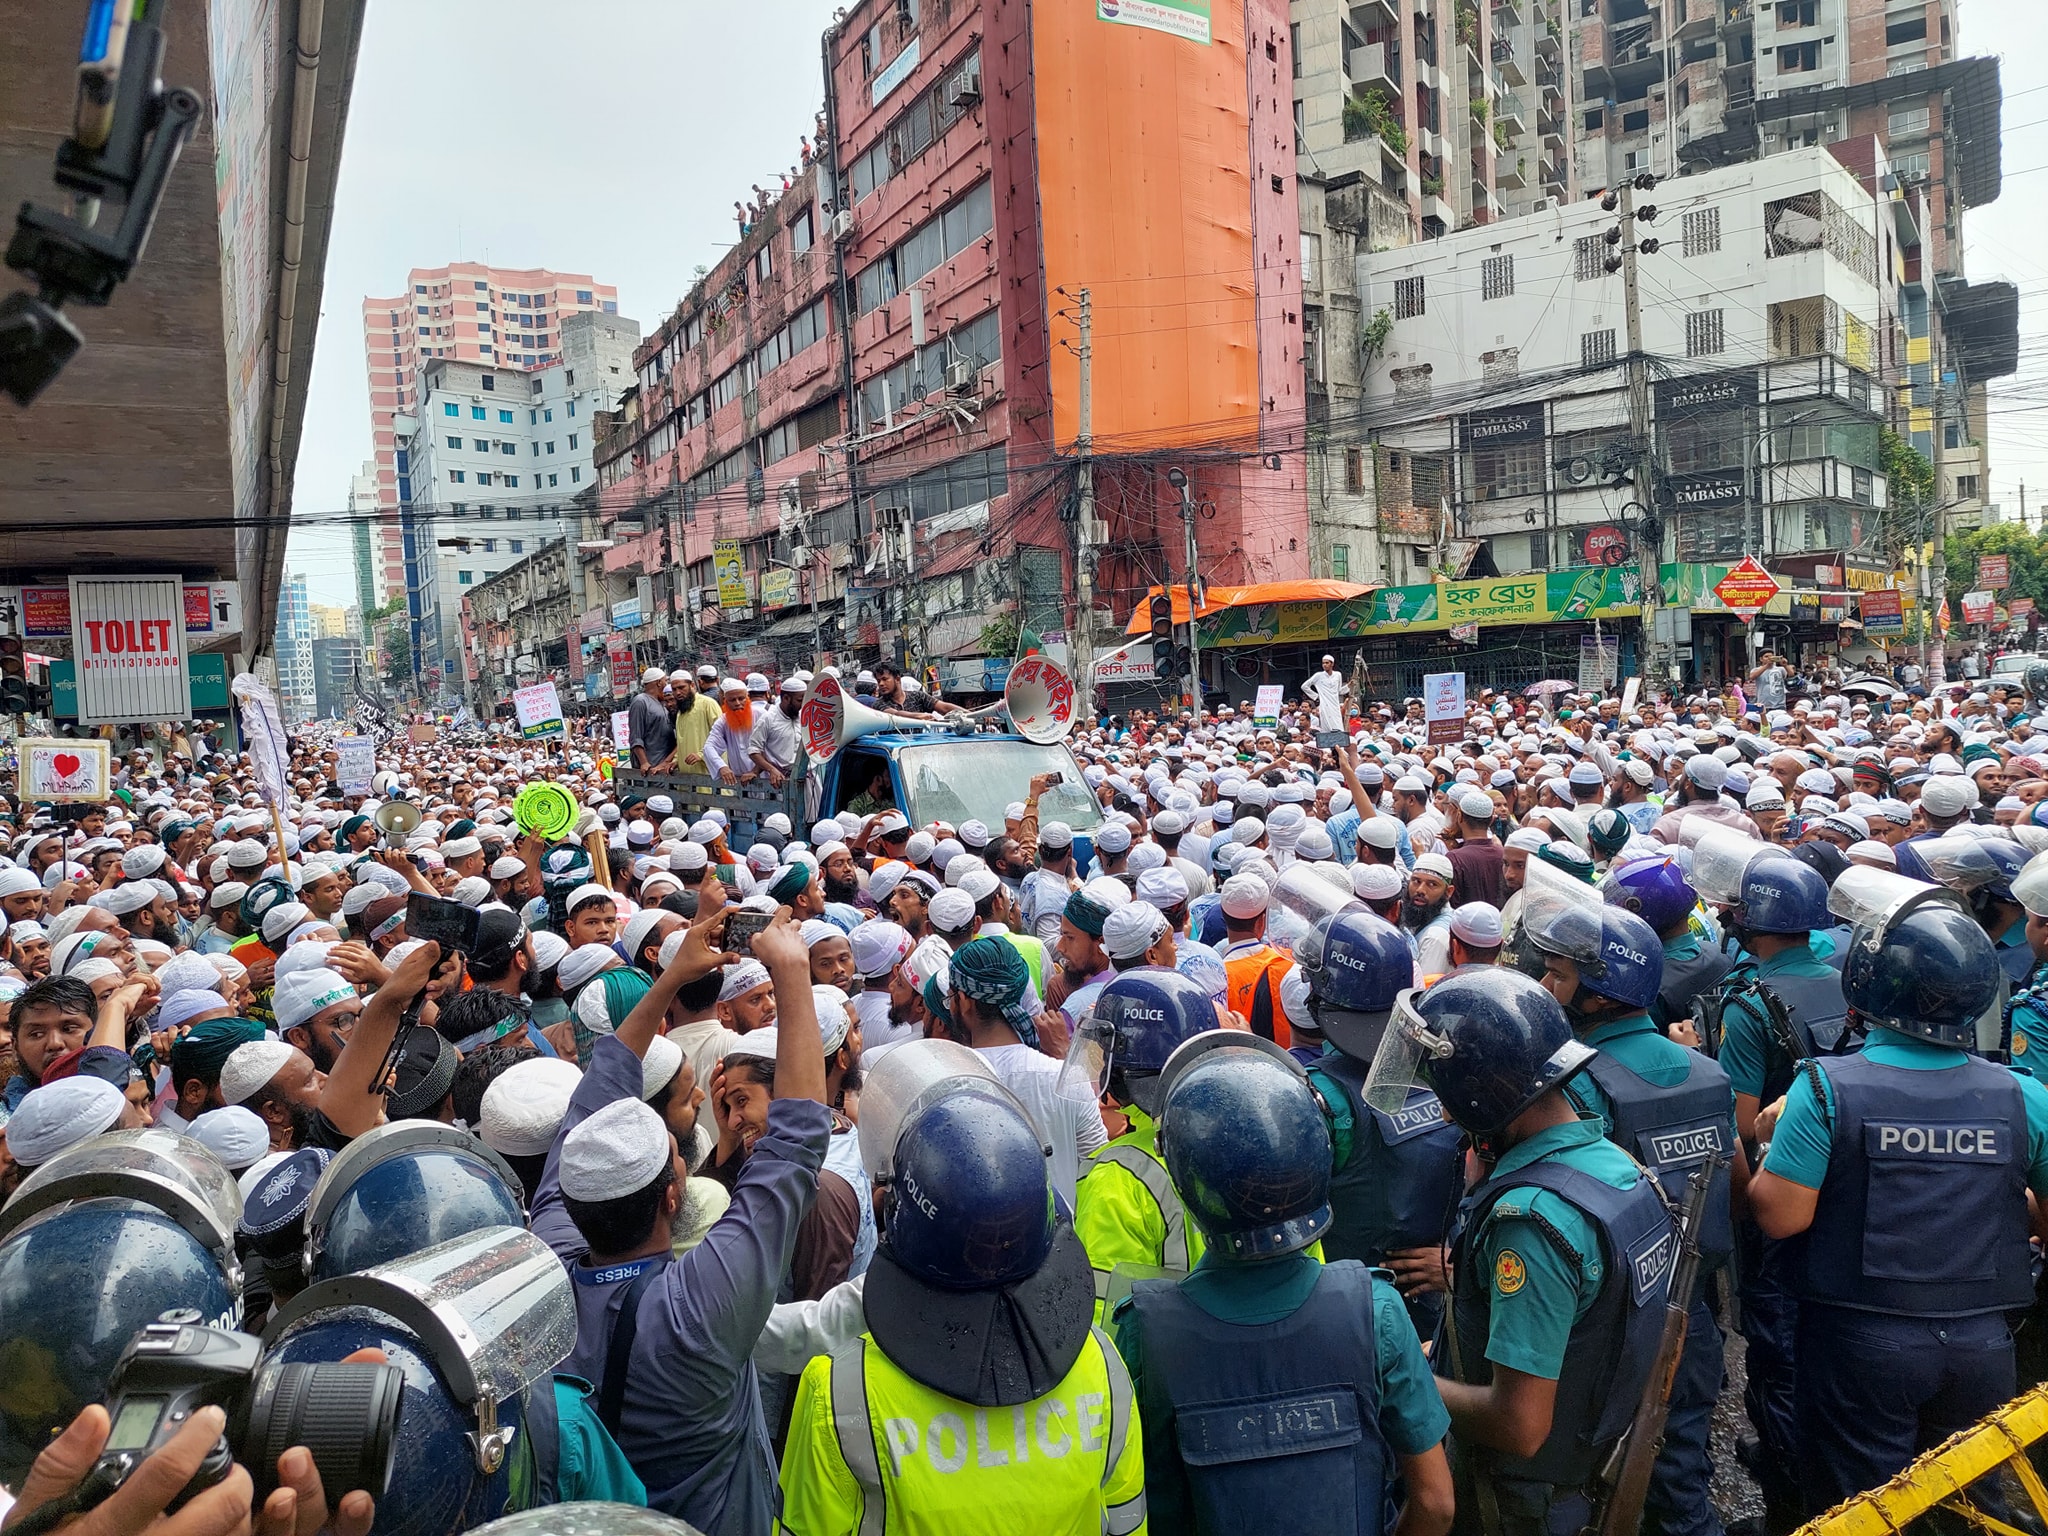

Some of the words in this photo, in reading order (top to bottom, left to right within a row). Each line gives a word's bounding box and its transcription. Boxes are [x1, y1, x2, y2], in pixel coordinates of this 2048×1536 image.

[1672, 386, 1740, 408] EMBASSY
[1472, 419, 1531, 438] EMBASSY
[1676, 485, 1743, 503] EMBASSY
[1445, 587, 1481, 605] হক
[1489, 583, 1537, 604] ব্রেড
[85, 620, 171, 653] TOLET
[1867, 626, 1902, 634] minister
[84, 656, 178, 669] 01711379308
[1041, 664, 1074, 723] মাইক
[1748, 883, 1782, 899] POLICE
[1330, 950, 1367, 972] POLICE
[1608, 941, 1648, 966] POLICE
[1123, 1007, 1164, 1021] POLICE
[1659, 1131, 1715, 1158] POLICE
[1880, 1126, 1997, 1155] POLICE
[903, 1169, 939, 1220] POLICE
[1640, 1241, 1668, 1283] POLICE
[595, 1264, 640, 1284] PRESS
[885, 1392, 1103, 1478] POLICE
